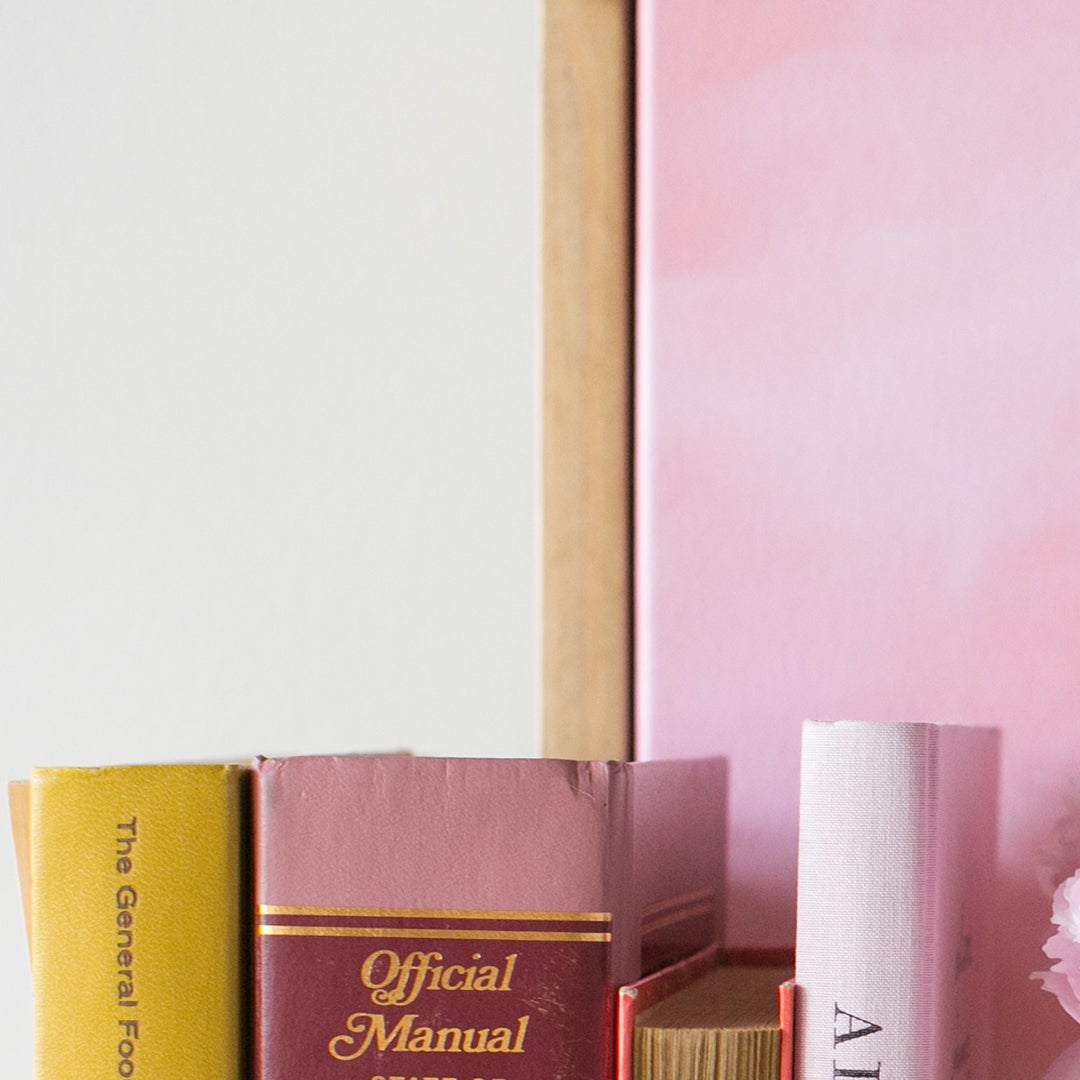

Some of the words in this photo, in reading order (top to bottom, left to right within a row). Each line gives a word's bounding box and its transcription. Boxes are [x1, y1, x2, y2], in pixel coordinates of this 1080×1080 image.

[116, 817, 138, 874] The
[116, 884, 138, 1008] General
[360, 949, 519, 1007] Official
[328, 1012, 531, 1062] Manual
